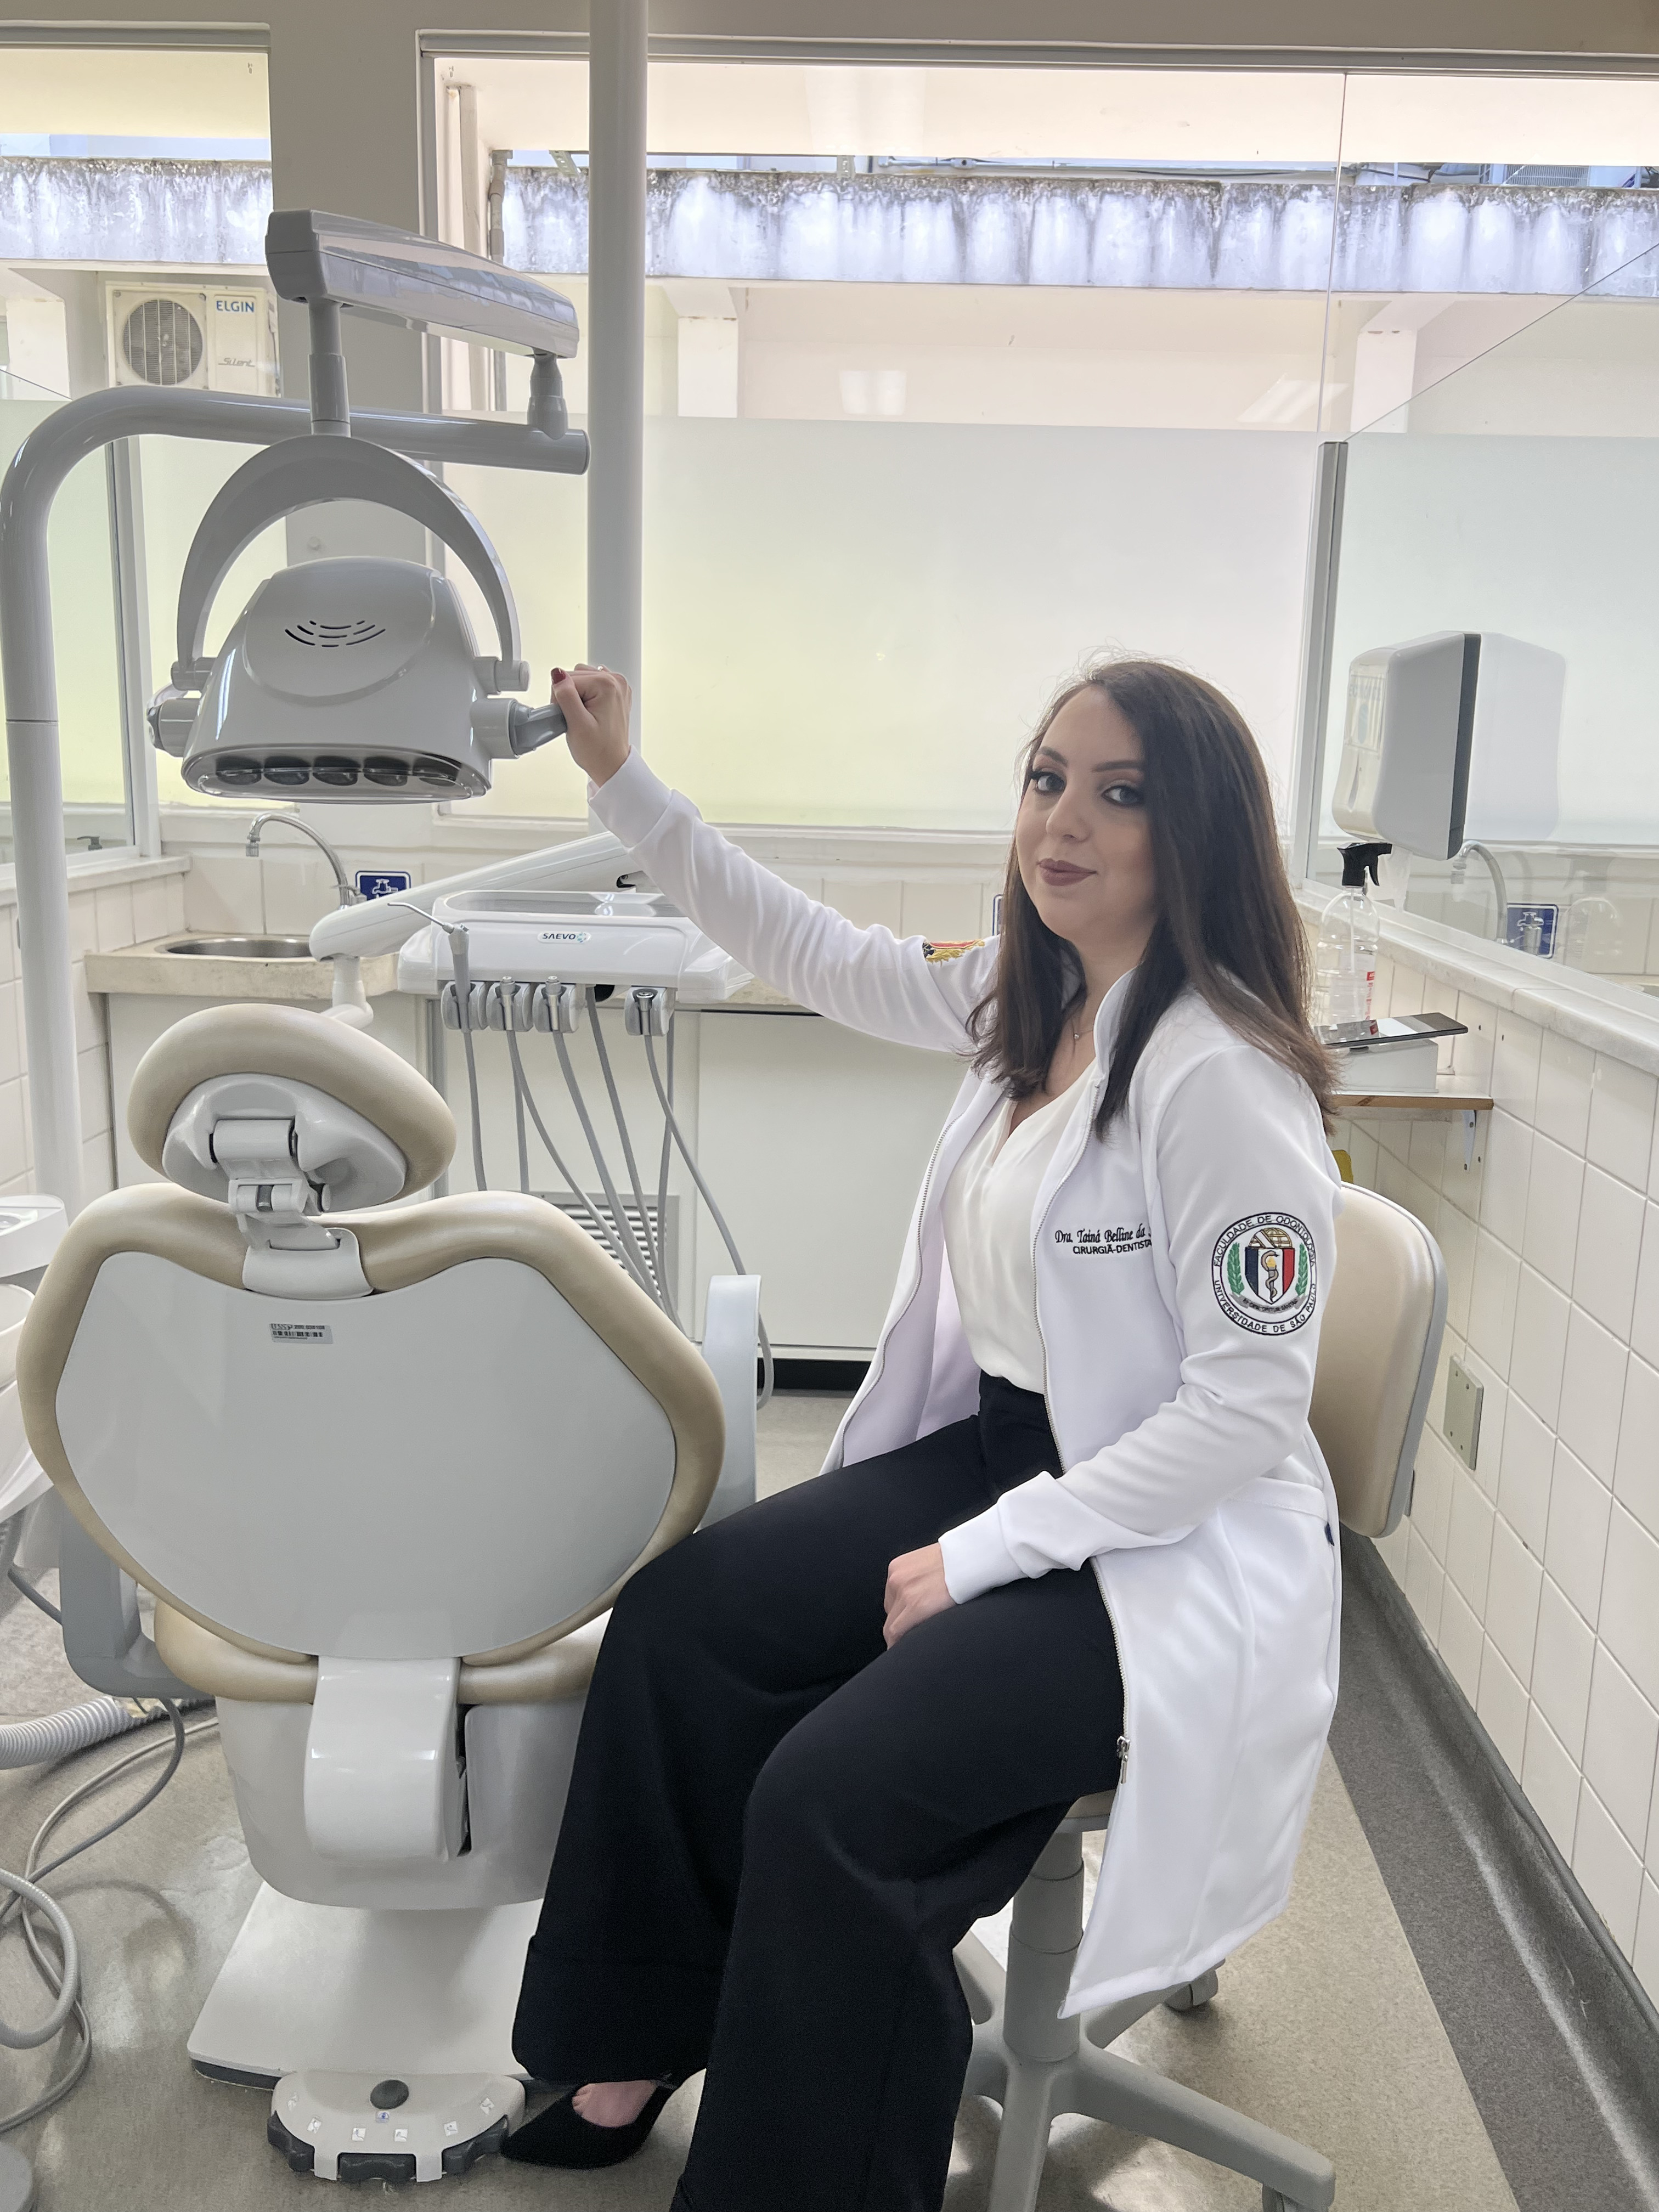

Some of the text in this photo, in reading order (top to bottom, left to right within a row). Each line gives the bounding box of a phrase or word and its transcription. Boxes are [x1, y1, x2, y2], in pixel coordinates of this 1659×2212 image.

[216, 300, 255, 312] ELGIN
[219, 357, 255, 367] Silent
[1054, 1229, 1073, 1243] Dra.
[1077, 1228, 1101, 1243] Tainá
[1136, 1223, 1146, 1239] da
[1214, 1219, 1255, 1267] FACULDADE
[1257, 1215, 1272, 1224] DE
[1073, 1239, 1152, 1255] CIRURGIÃ-DENTISTA
[1214, 1279, 1267, 1333] UNIVERSIDADE
[1273, 1324, 1286, 1333] DE
[1289, 1314, 1306, 1328] SÃO
[1305, 1283, 1316, 1313] PAULO
